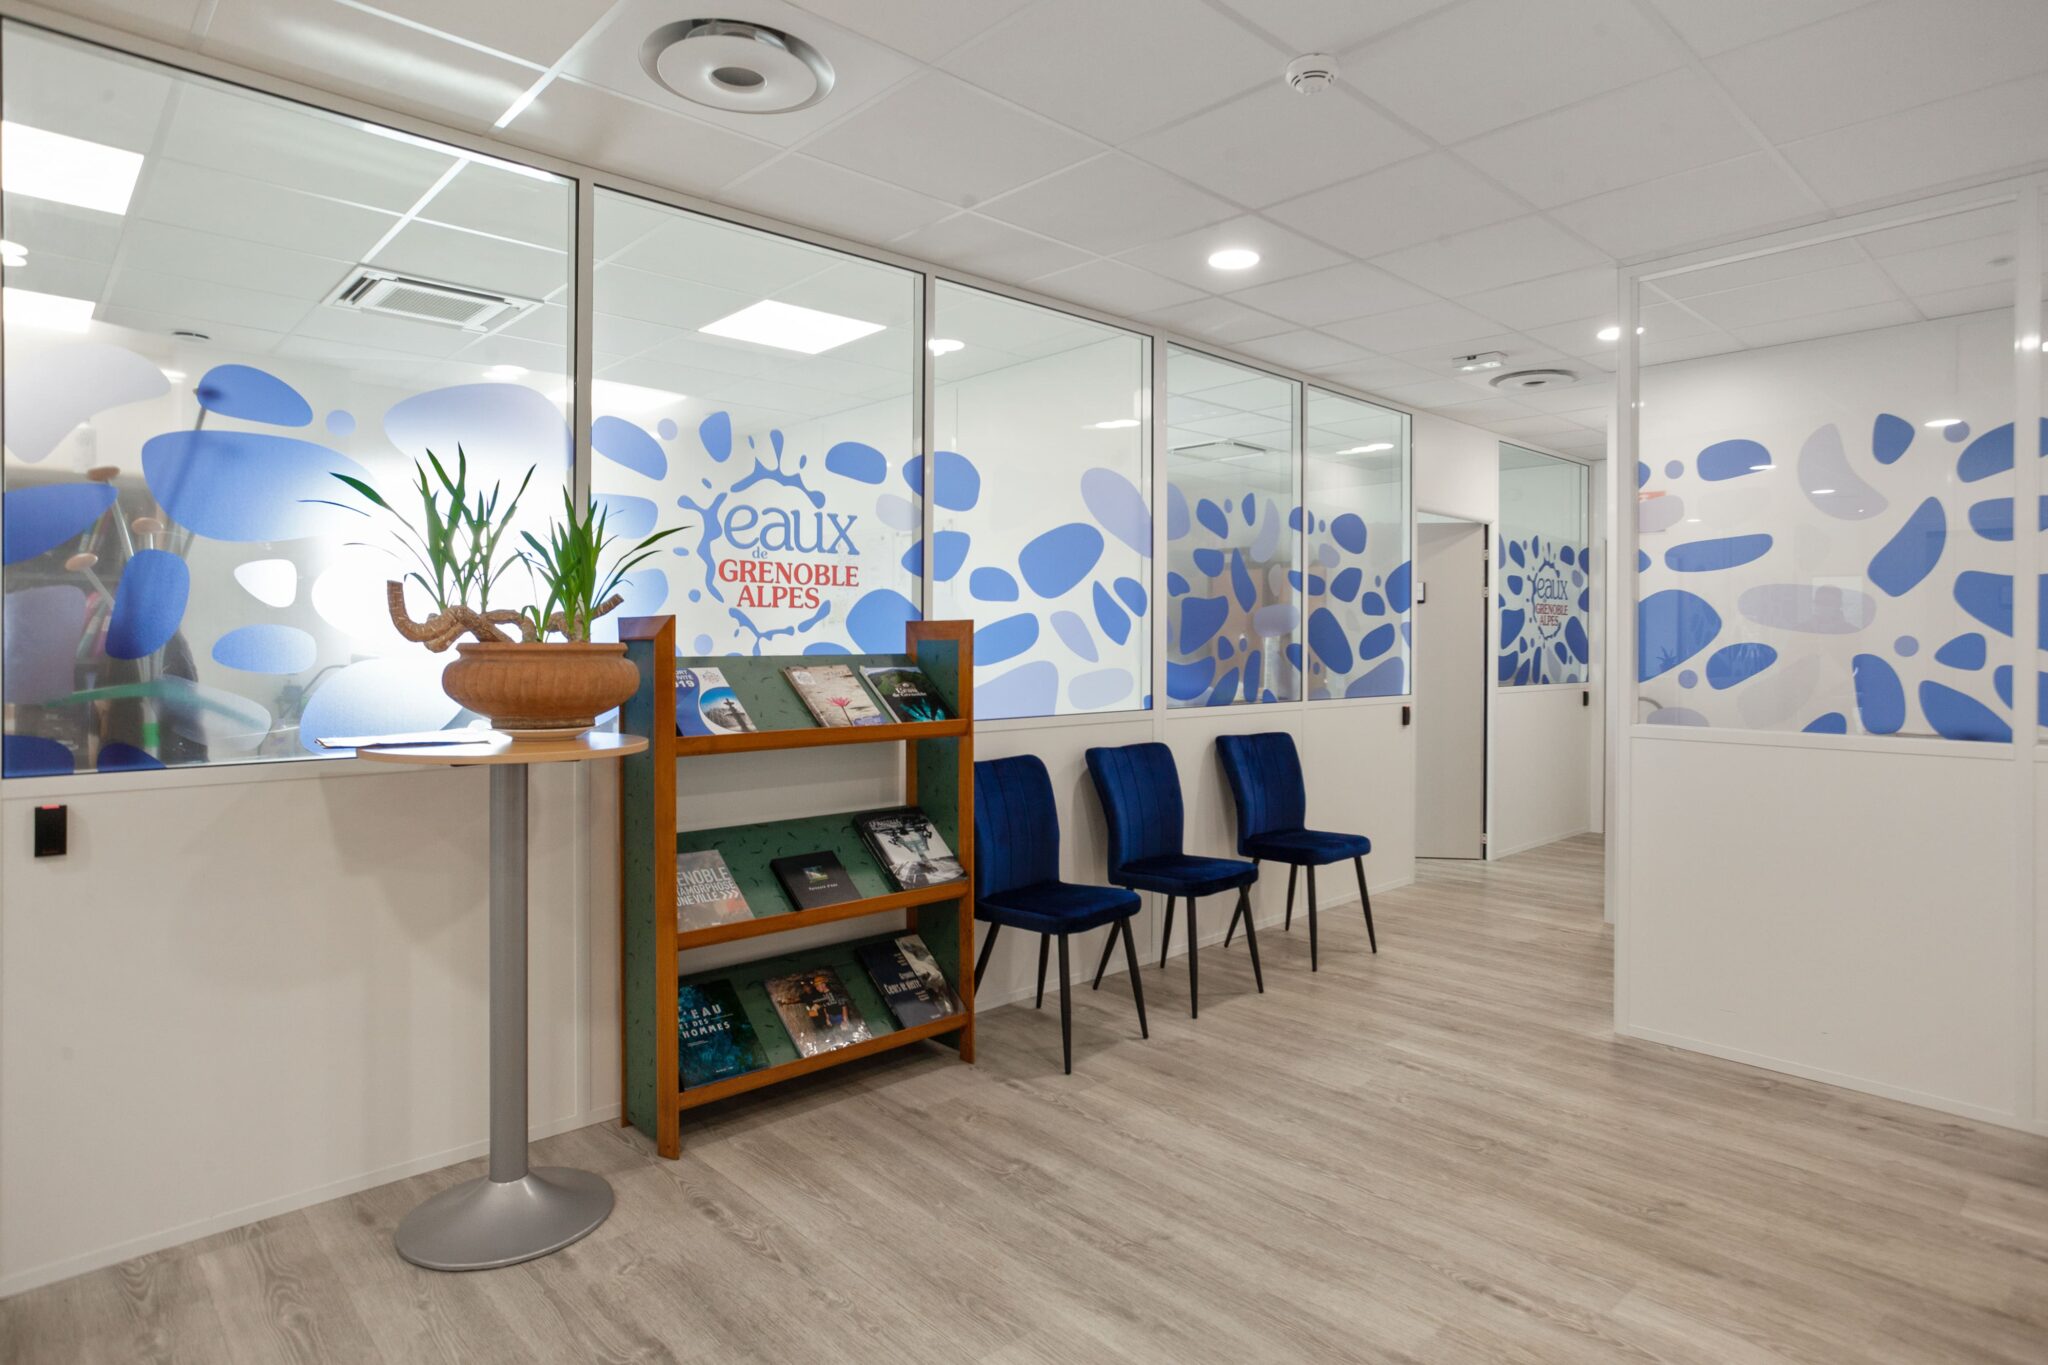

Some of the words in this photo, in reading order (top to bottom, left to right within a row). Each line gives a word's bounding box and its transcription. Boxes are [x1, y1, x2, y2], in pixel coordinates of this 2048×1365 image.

[724, 504, 860, 555] eaux
[752, 546, 768, 560] de
[718, 559, 860, 588] GRENOBLE
[736, 584, 820, 609] ALPES
[1536, 578, 1568, 600] eaux
[1536, 603, 1568, 616] GRENOBLE
[1540, 615, 1559, 627] ALPES
[677, 866, 731, 887] ENOBLE
[682, 1020, 730, 1039] HOMMES
[692, 1018, 709, 1028] DES
